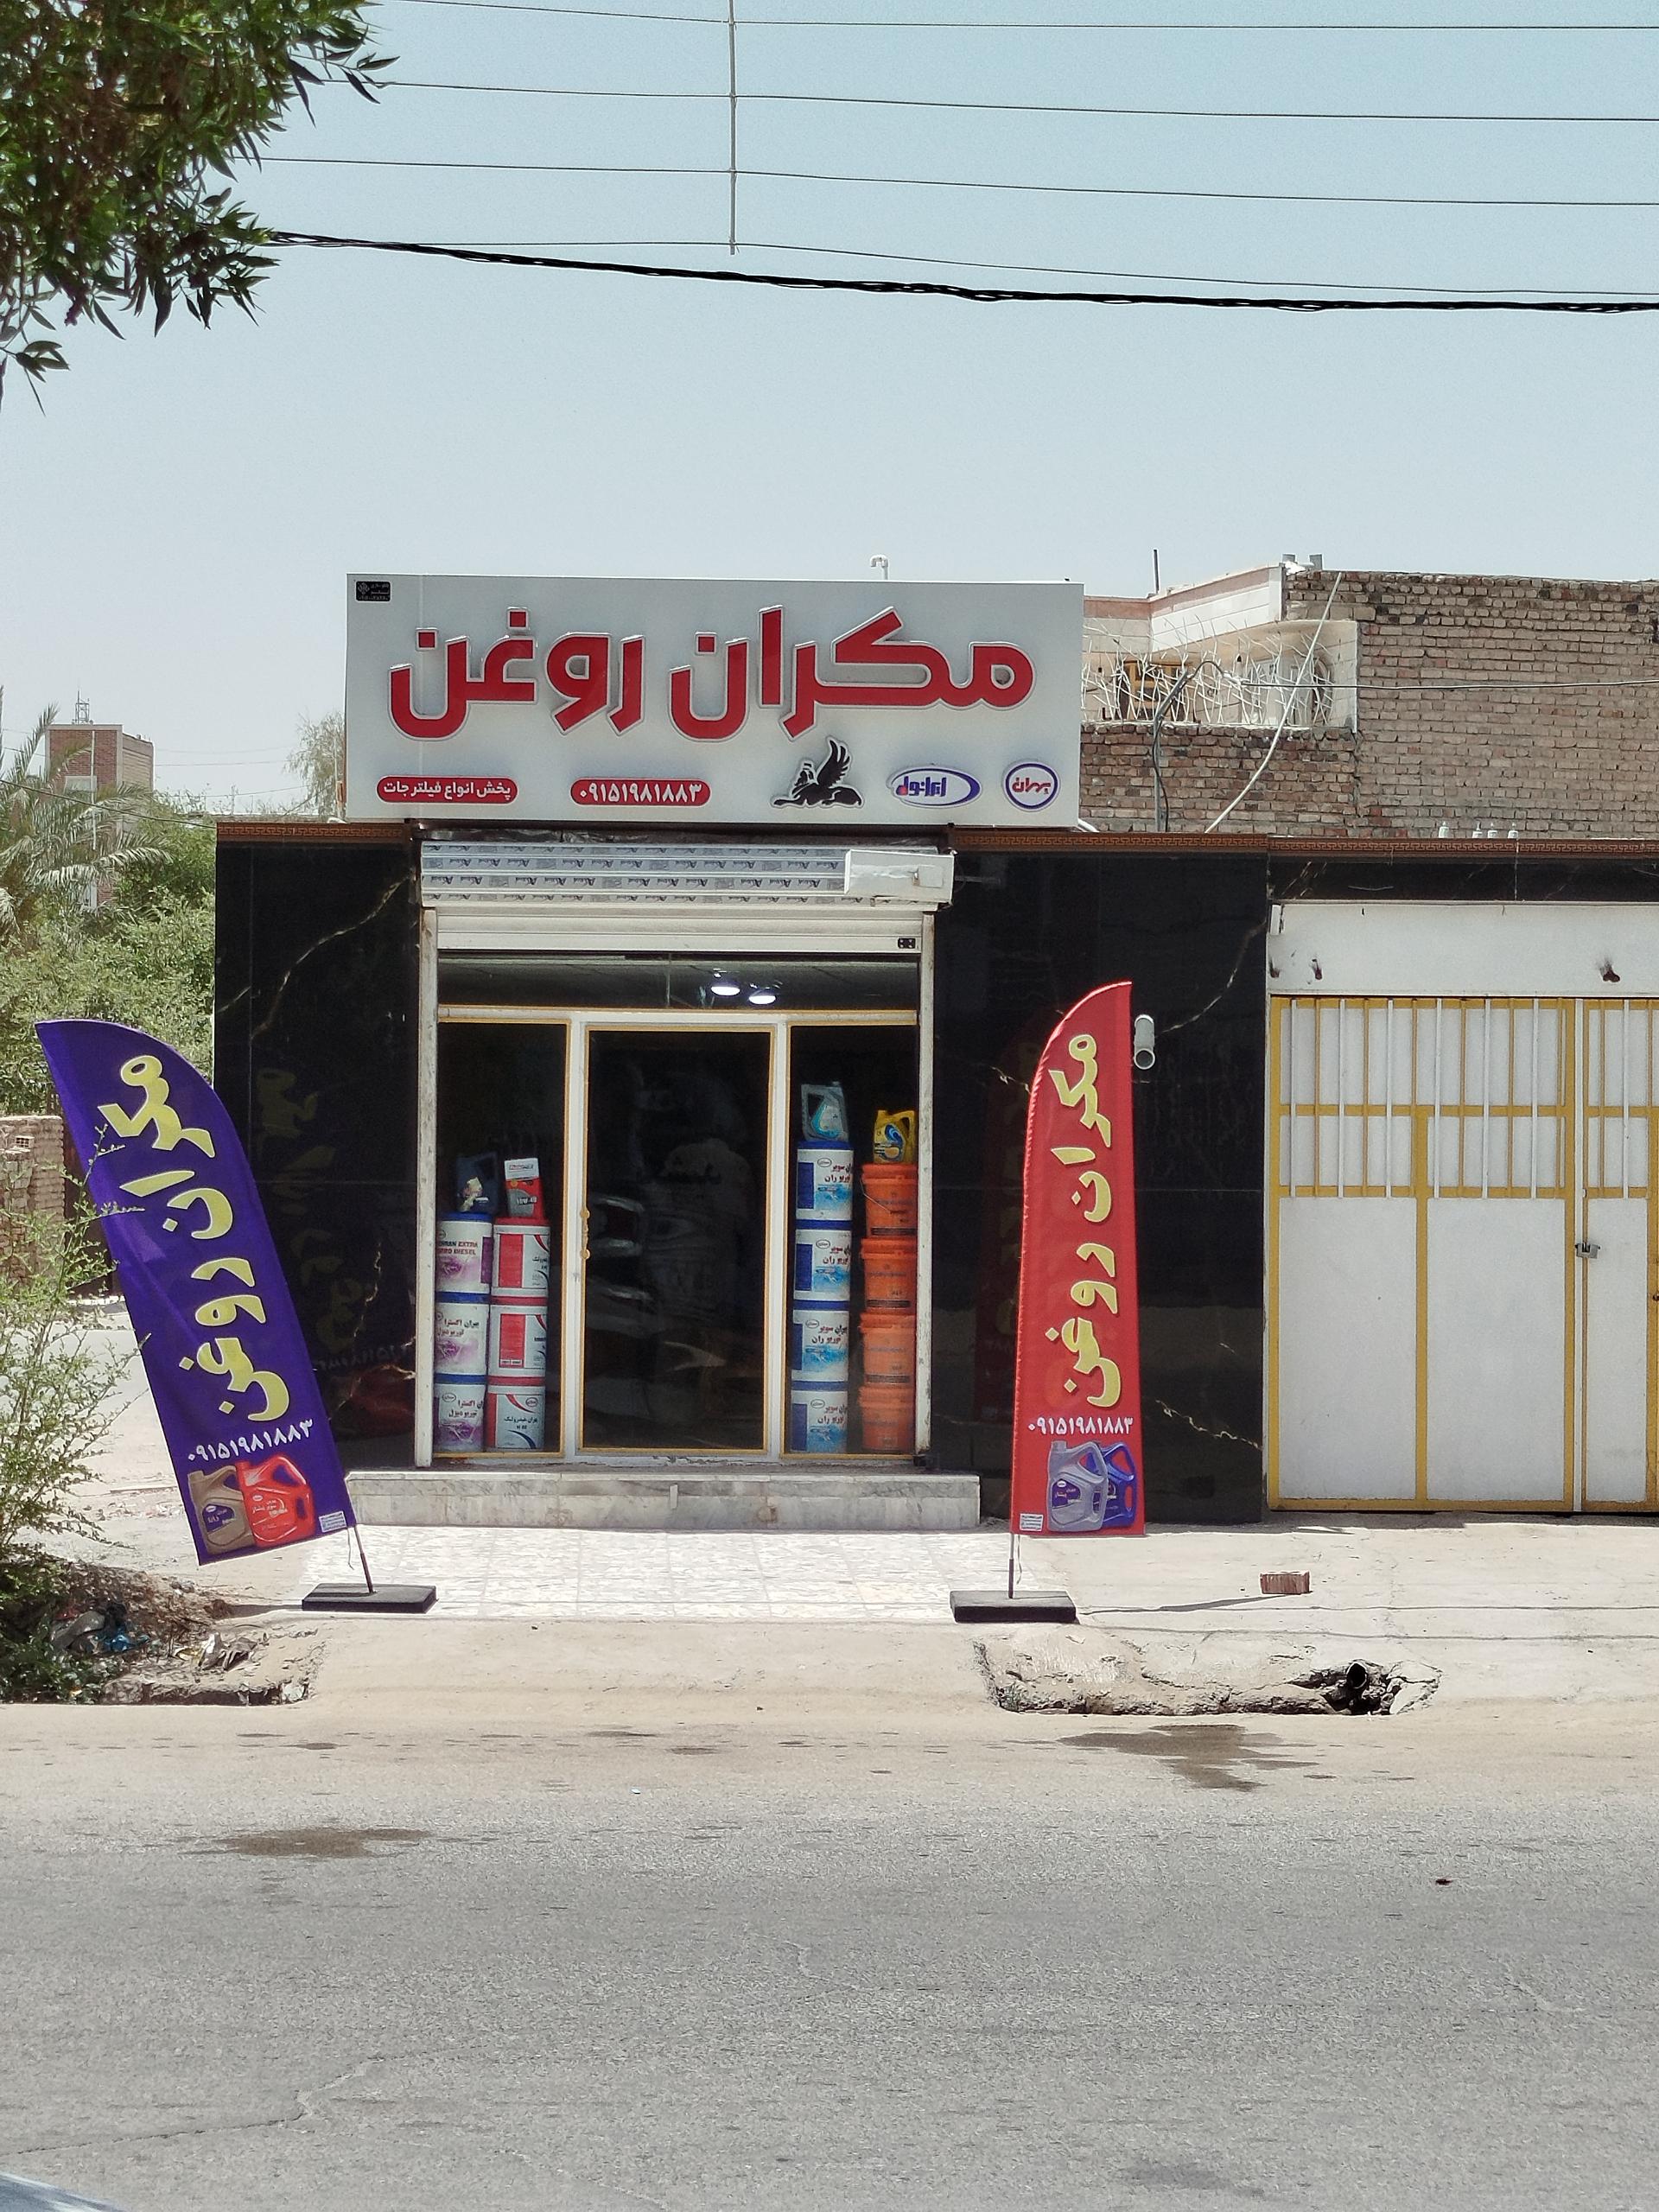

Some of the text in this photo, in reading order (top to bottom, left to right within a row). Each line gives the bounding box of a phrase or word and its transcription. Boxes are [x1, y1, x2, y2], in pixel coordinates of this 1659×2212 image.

[388, 605, 1036, 741] مکران روغن
[383, 780, 512, 800] پخش انواع فیلتر جات
[580, 782, 702, 803] ۰۹۱۵۱۹۸۱۸۸۳
[97, 1054, 291, 1422] مکران روغن
[1044, 1033, 1122, 1408] مکران روغن
[188, 1418, 314, 1462] ۰۹۱۵۱۹۸۱۸۸۳
[1027, 1416, 1134, 1435] ۰۹۱۵۱۹۸۱۸۸۳
